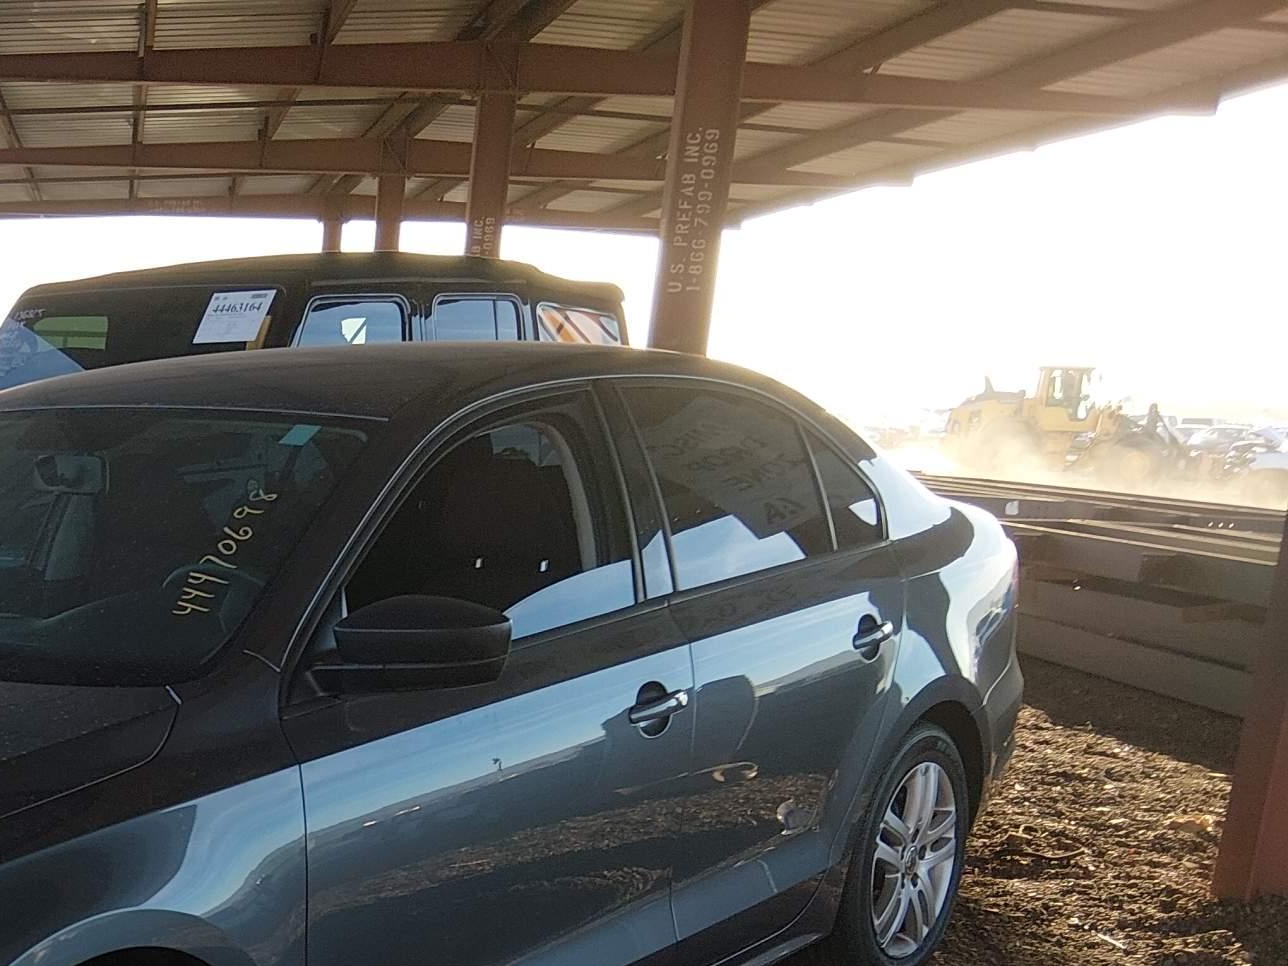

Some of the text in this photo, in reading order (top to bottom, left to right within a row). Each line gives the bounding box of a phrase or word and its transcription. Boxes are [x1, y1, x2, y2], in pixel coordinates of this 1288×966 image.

[667, 127, 703, 293] U.S. PREFAB INC.
[686, 128, 720, 292] 1-866-799-0969
[172, 488, 279, 616] 44470698
